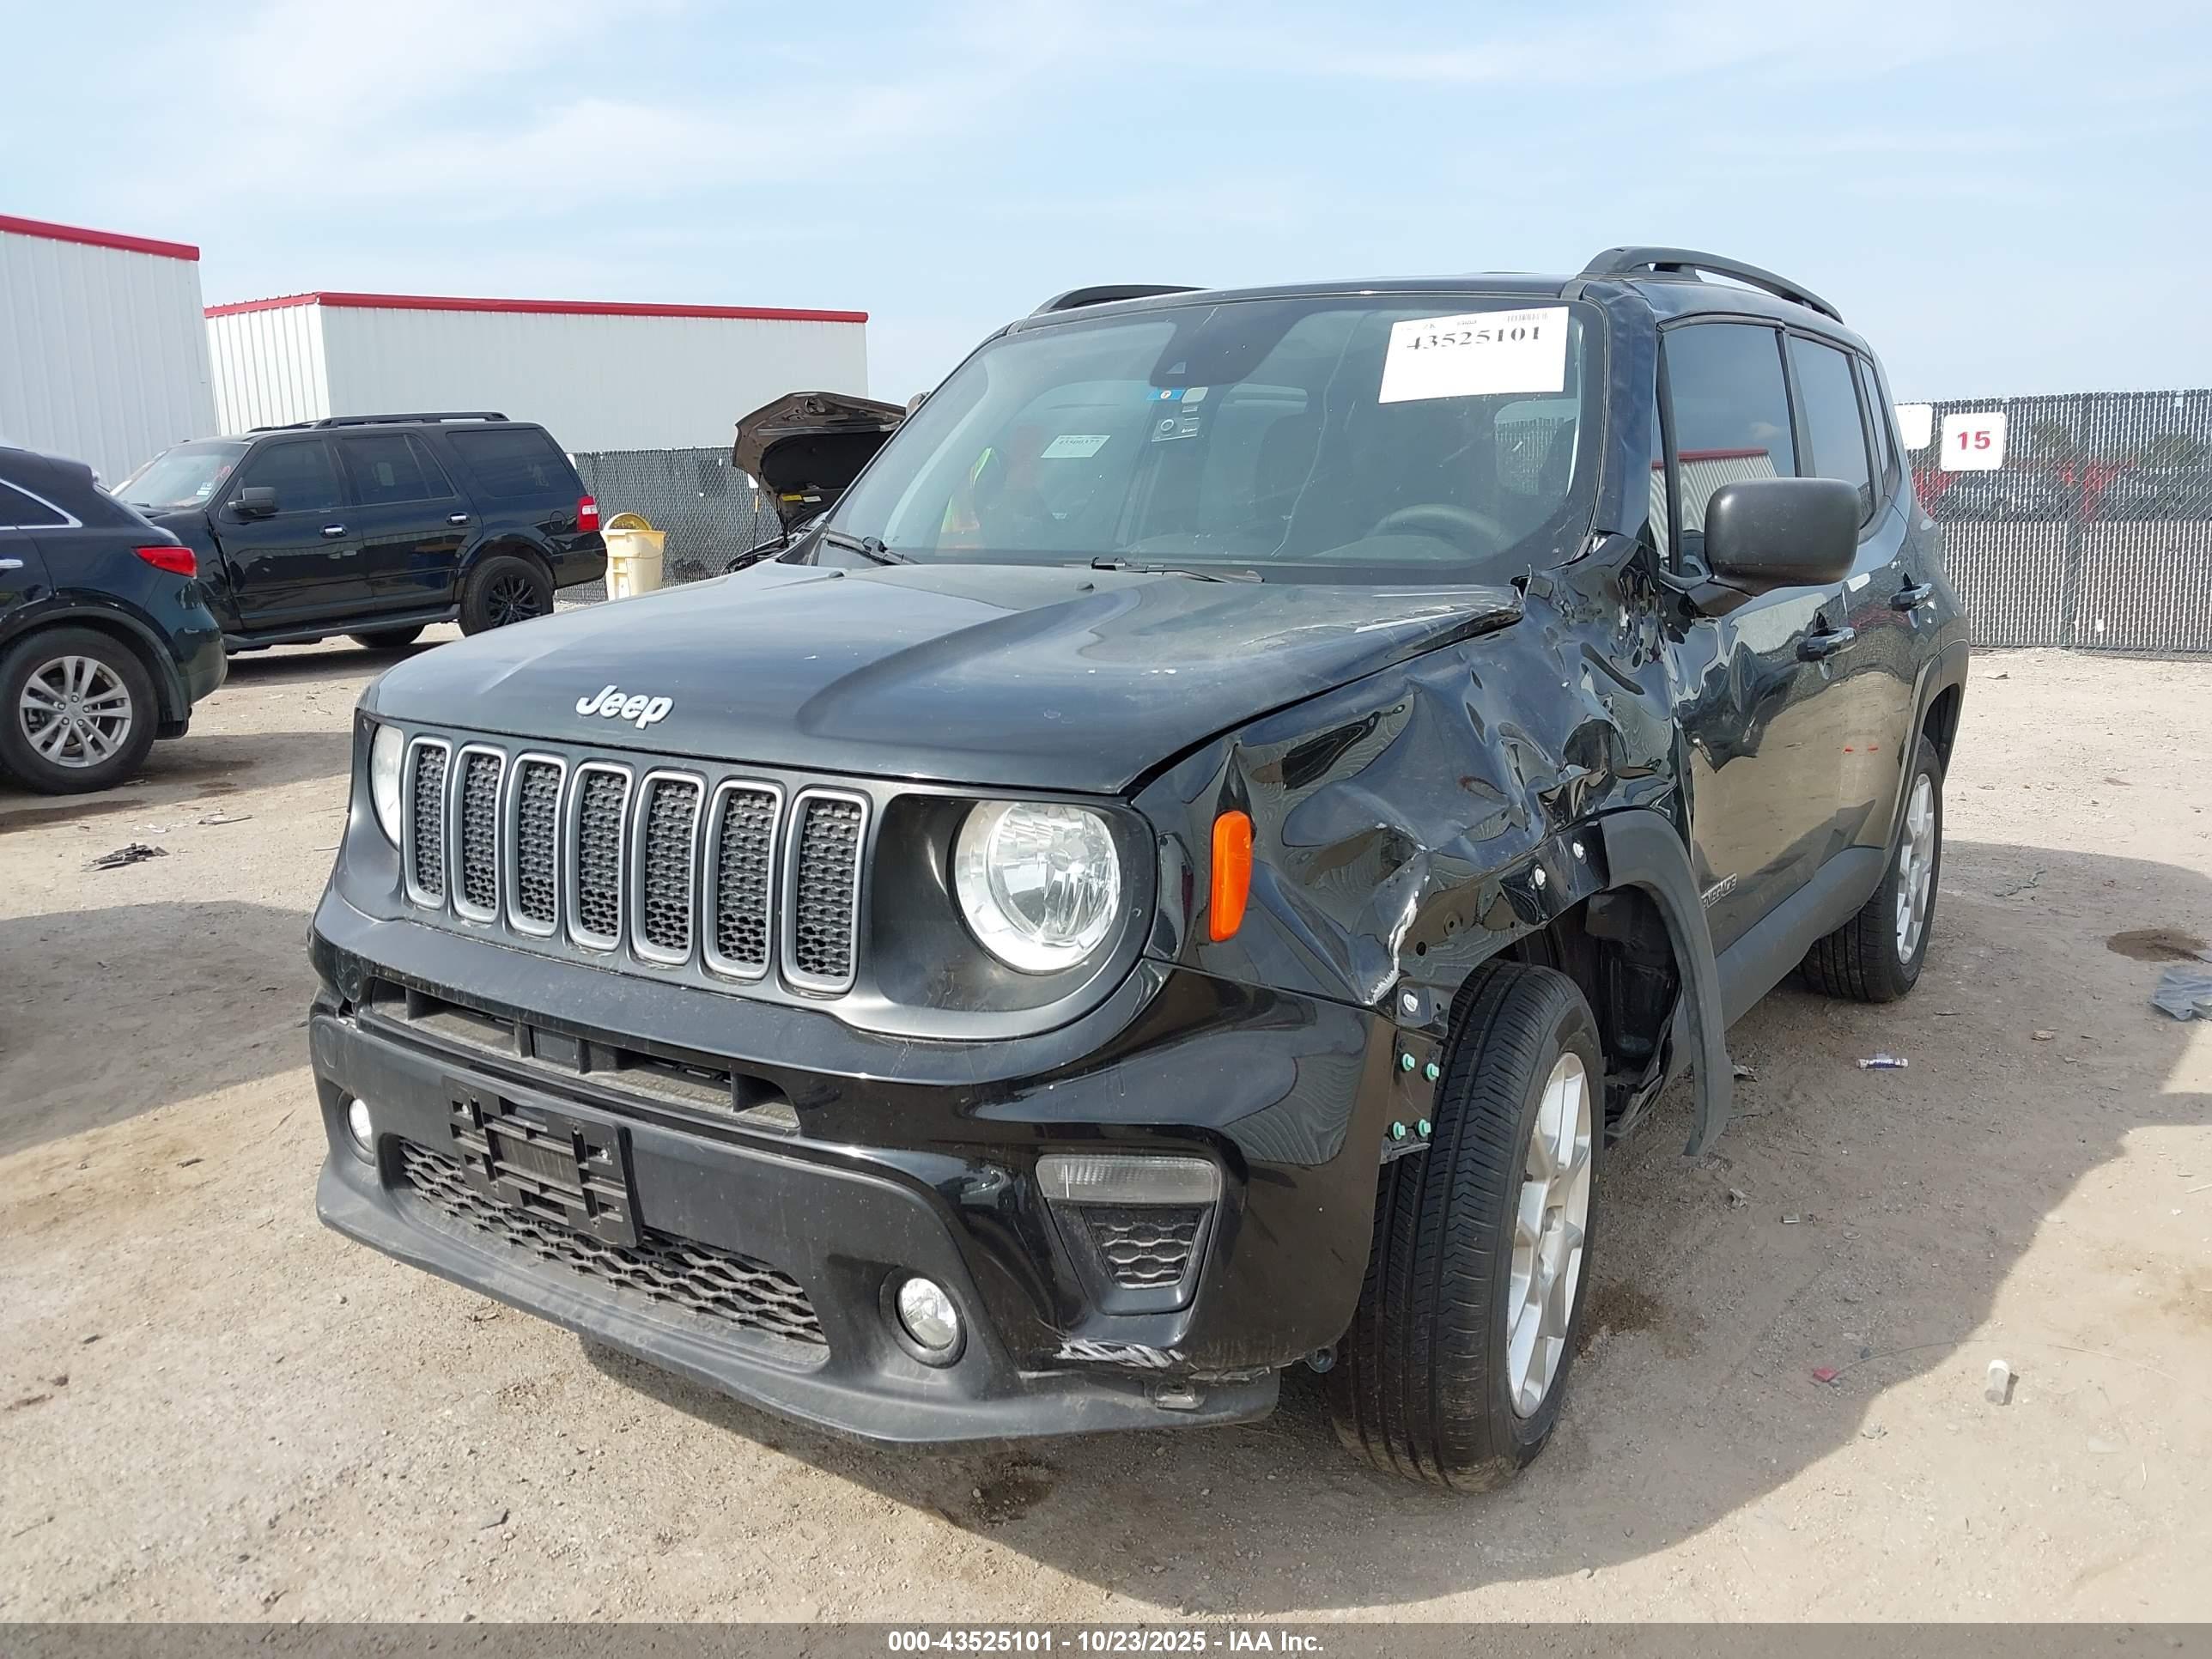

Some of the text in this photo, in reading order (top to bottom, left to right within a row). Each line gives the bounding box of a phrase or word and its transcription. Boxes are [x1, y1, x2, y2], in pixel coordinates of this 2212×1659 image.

[1406, 325, 1540, 350] 43525101
[1957, 430, 1991, 451] 15
[574, 684, 673, 730] Jeep
